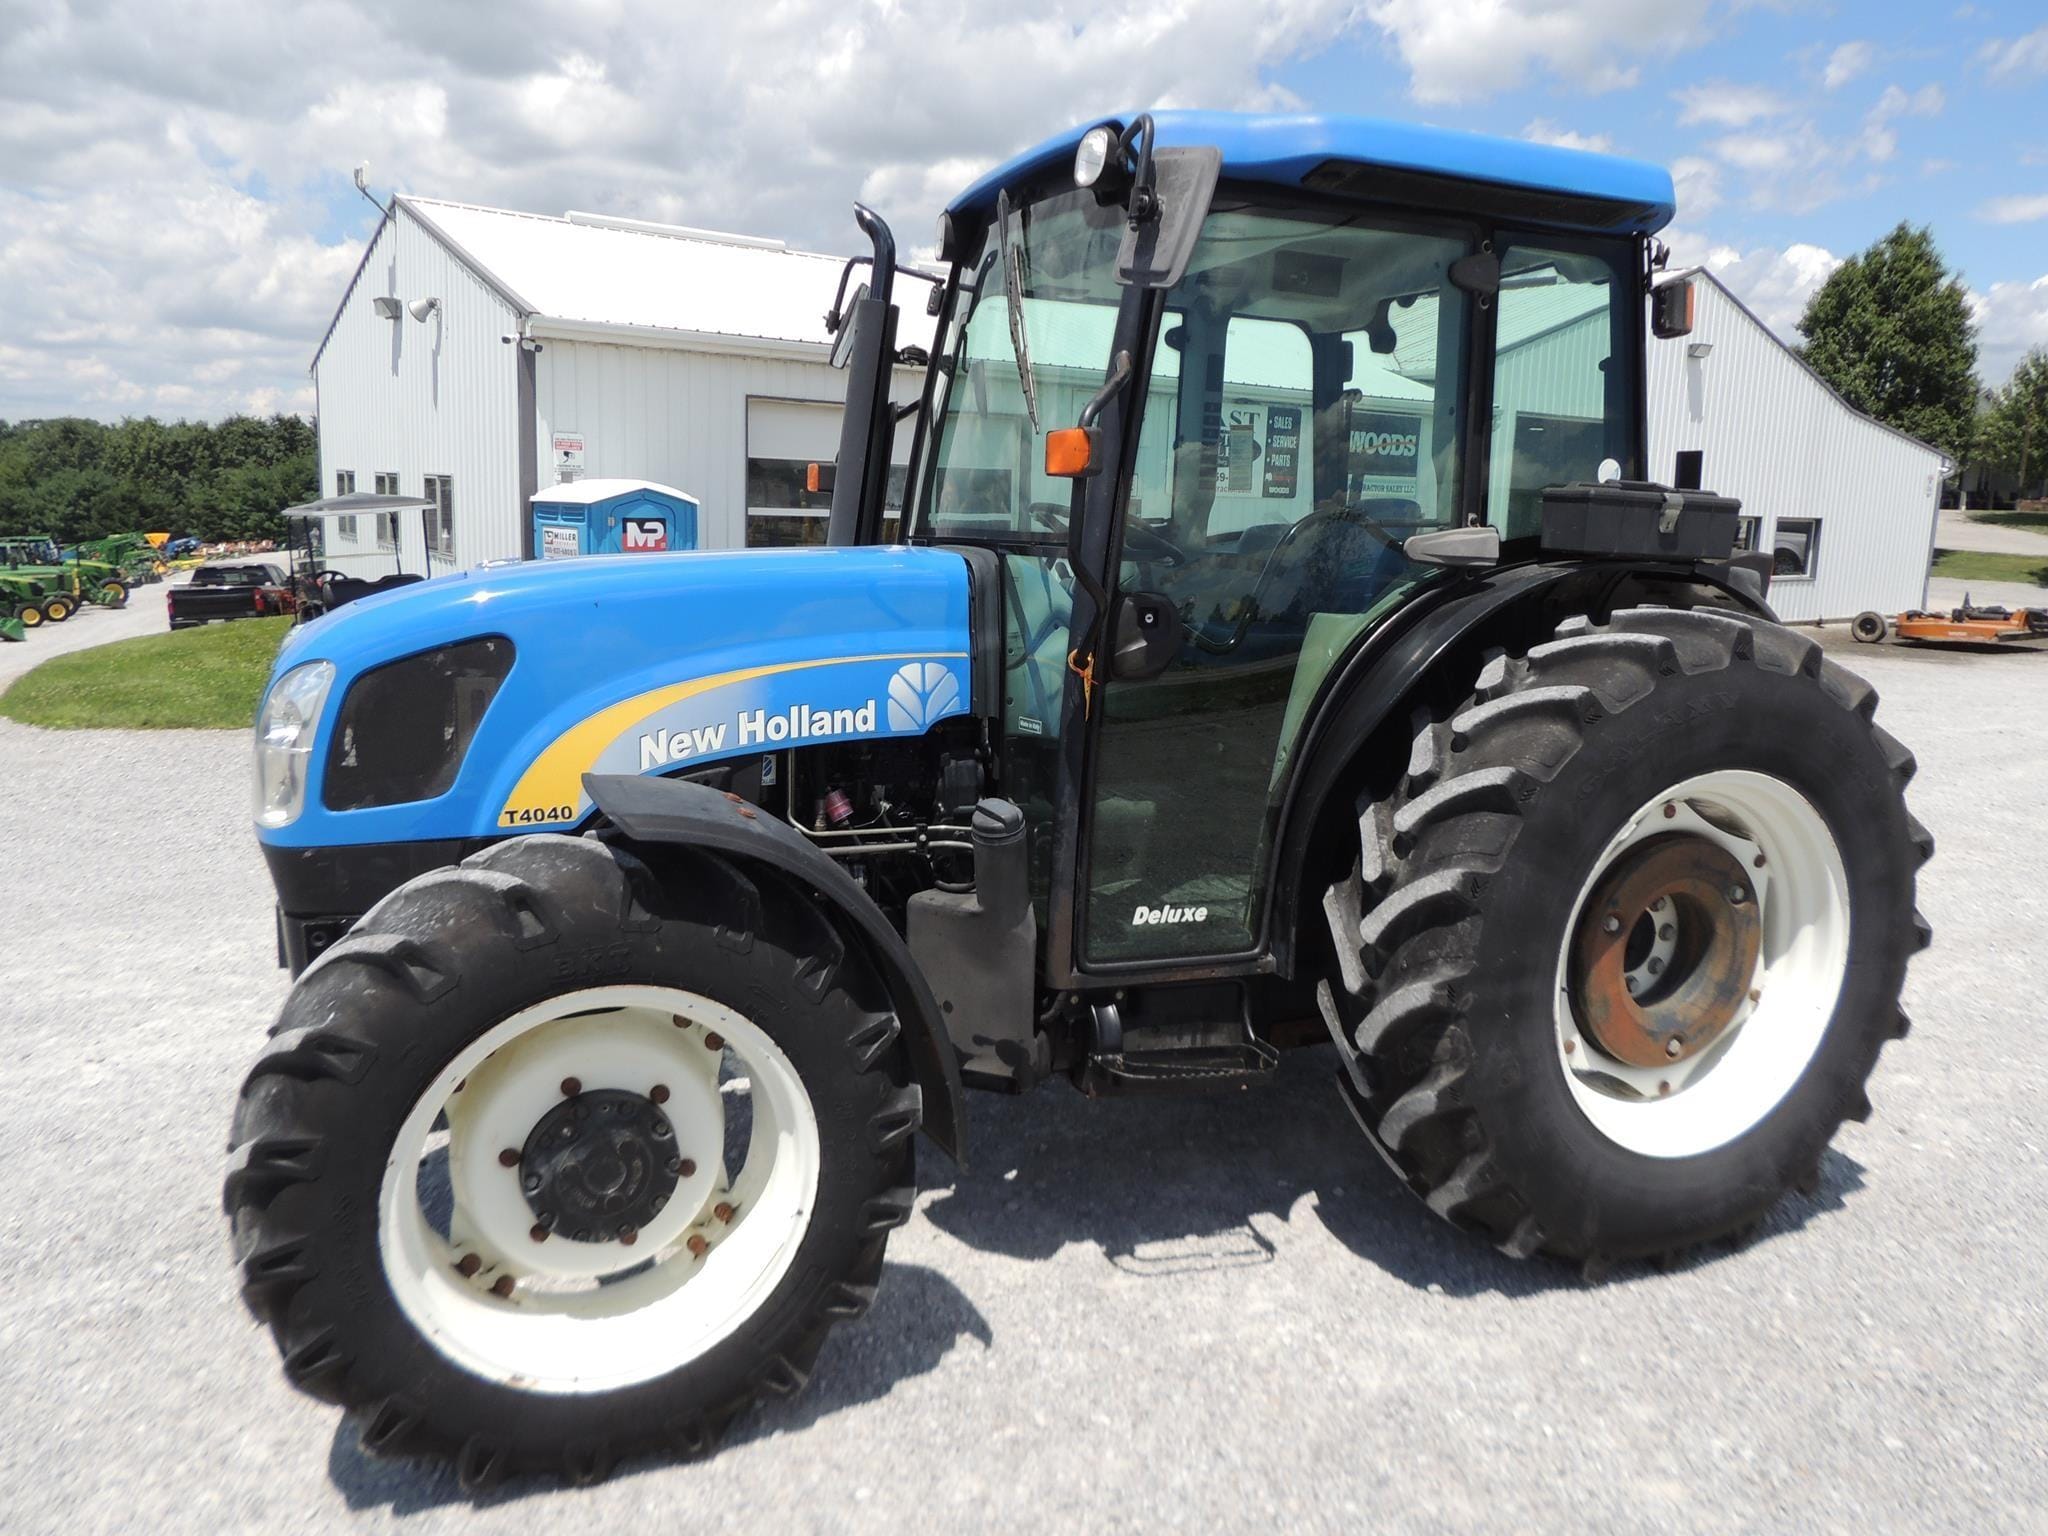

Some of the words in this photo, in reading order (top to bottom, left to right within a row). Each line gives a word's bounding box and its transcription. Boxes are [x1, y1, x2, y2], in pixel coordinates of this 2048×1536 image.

[1274, 416, 1293, 429] SALES
[1272, 435, 1297, 448] SERVICE
[1349, 430, 1416, 456] WOODS
[1271, 454, 1291, 467] PARTS
[1386, 484, 1403, 493] SALES
[1404, 485, 1415, 493] LLC
[554, 532, 577, 541] MILLER
[626, 521, 665, 547] MP
[639, 722, 727, 770] New
[738, 699, 876, 745] Holland
[504, 806, 573, 824] T4040
[1132, 904, 1208, 925] Deluxe
